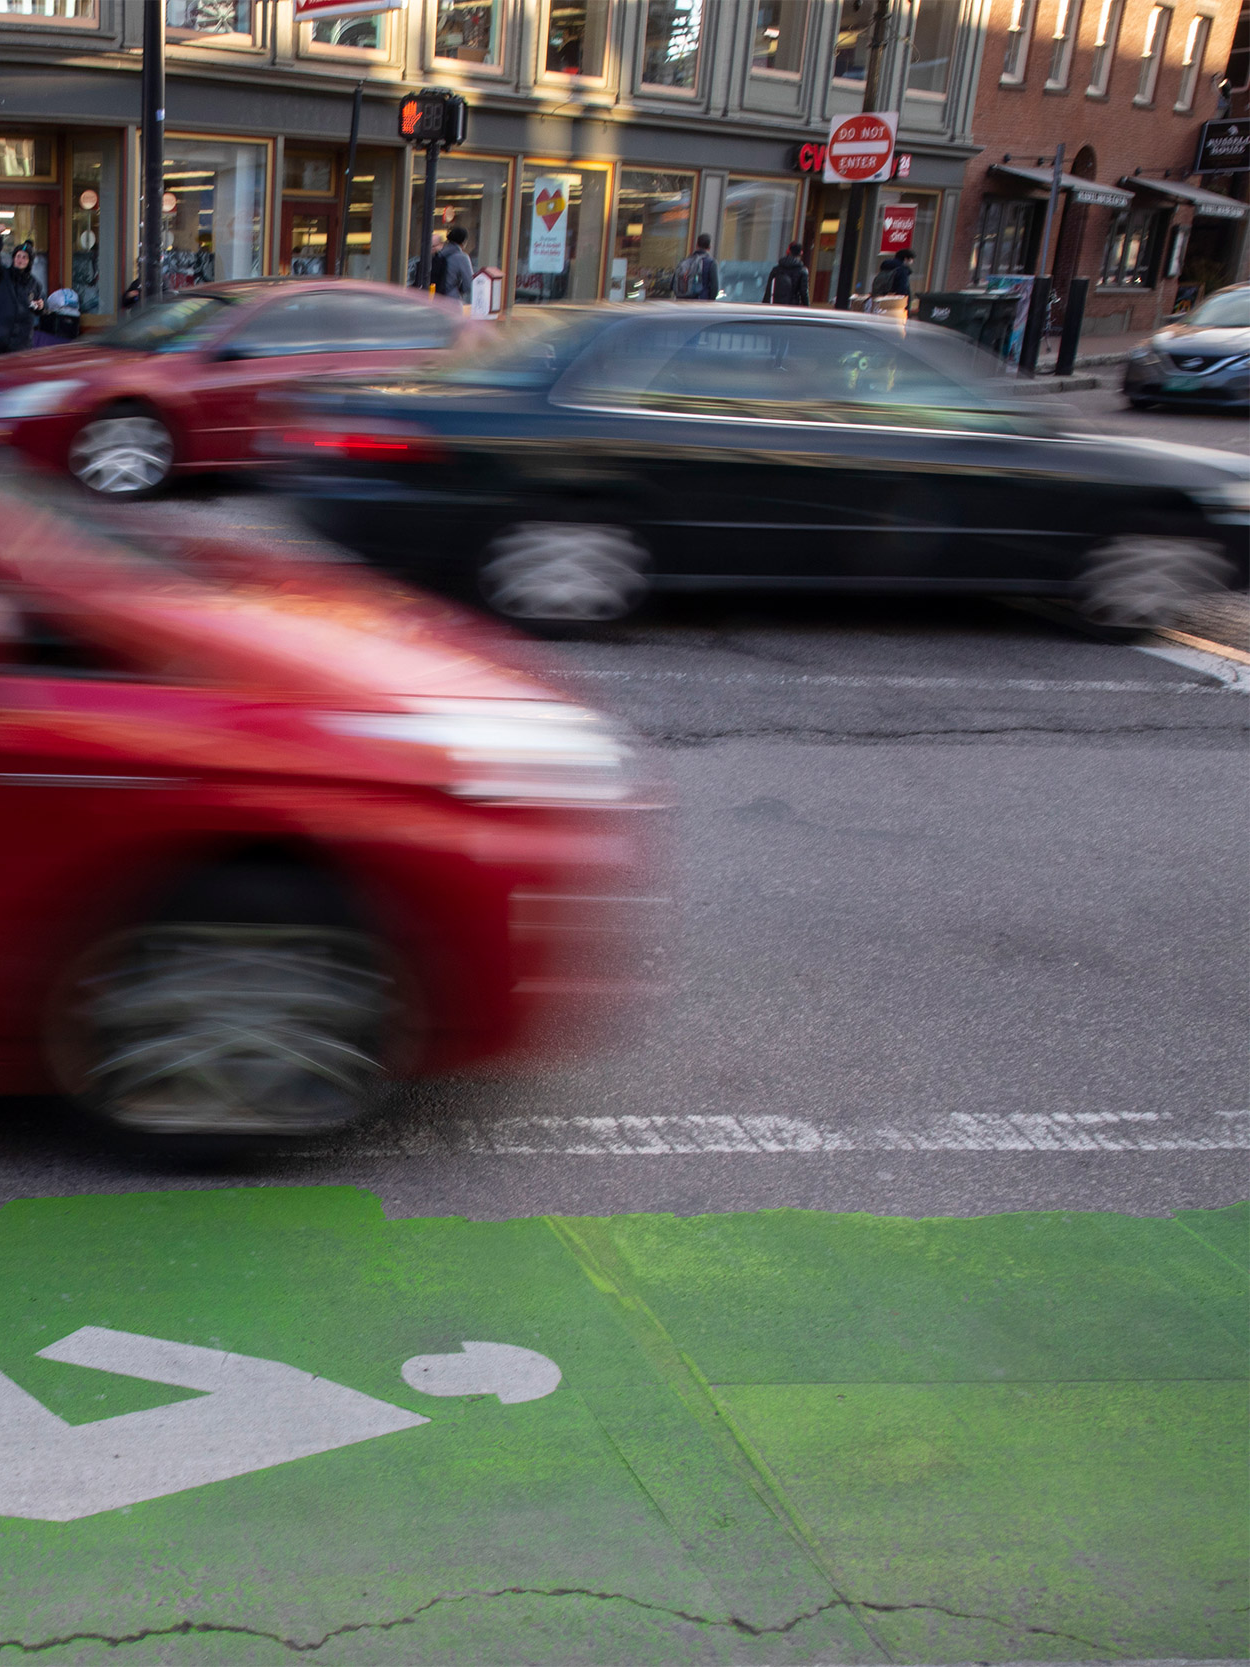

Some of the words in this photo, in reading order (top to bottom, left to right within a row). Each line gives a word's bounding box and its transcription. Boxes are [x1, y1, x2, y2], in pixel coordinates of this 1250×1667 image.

[838, 128, 856, 140] DO
[860, 126, 886, 139] NOT
[840, 157, 877, 169] ENTER
